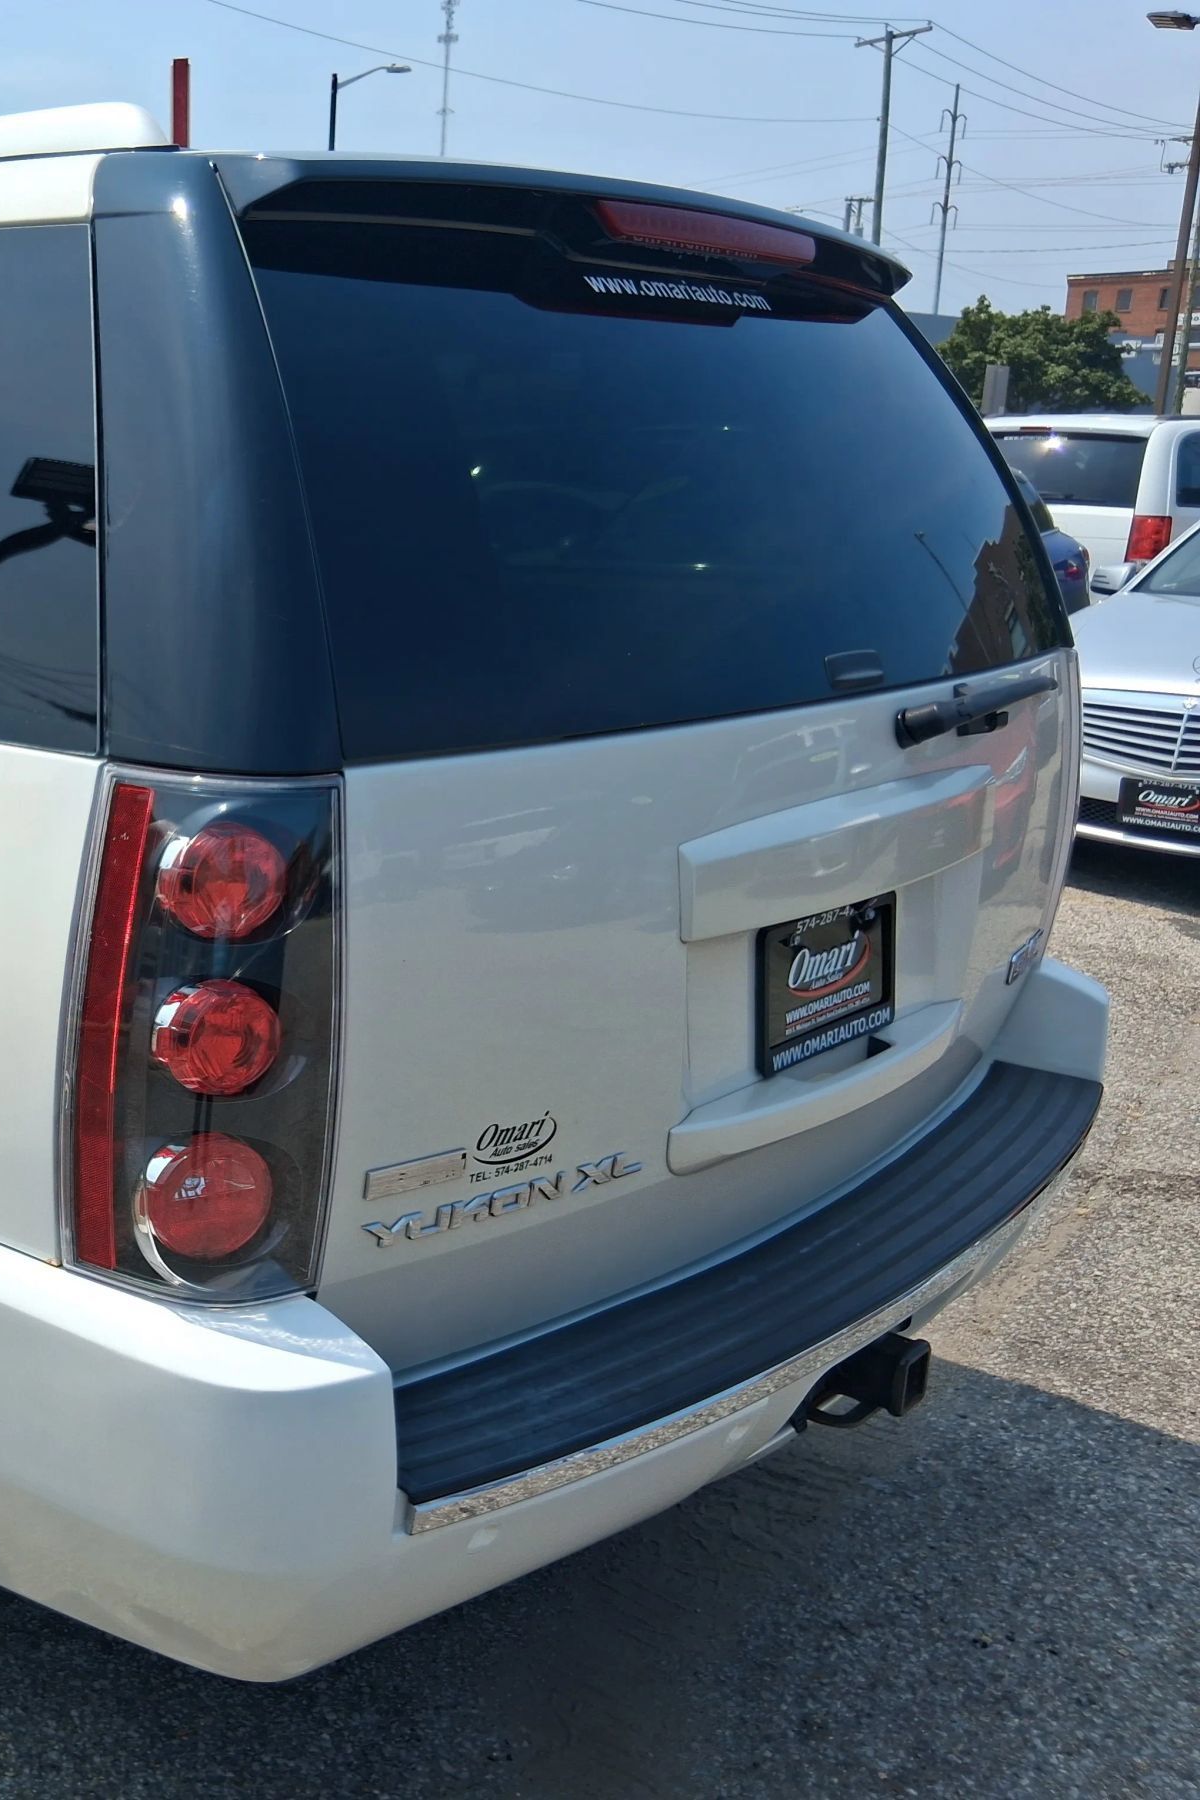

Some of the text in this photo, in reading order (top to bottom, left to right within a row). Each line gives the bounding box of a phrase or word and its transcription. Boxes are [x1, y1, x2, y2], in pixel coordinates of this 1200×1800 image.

[584, 275, 772, 311] www.omariauto.com
[1139, 790, 1192, 806] Omari
[796, 905, 855, 935] 574-287-4
[788, 929, 860, 989] Omari
[785, 982, 870, 1024] WWW.OMARIAUTO.COM
[773, 1007, 890, 1071] WWW.OMARIAUTO.COM
[476, 1111, 550, 1151] Omari
[489, 1139, 540, 1159] Auto sales
[469, 1154, 553, 1184] TEL: 574-287-4714
[361, 1152, 643, 1248] YUKON XL
